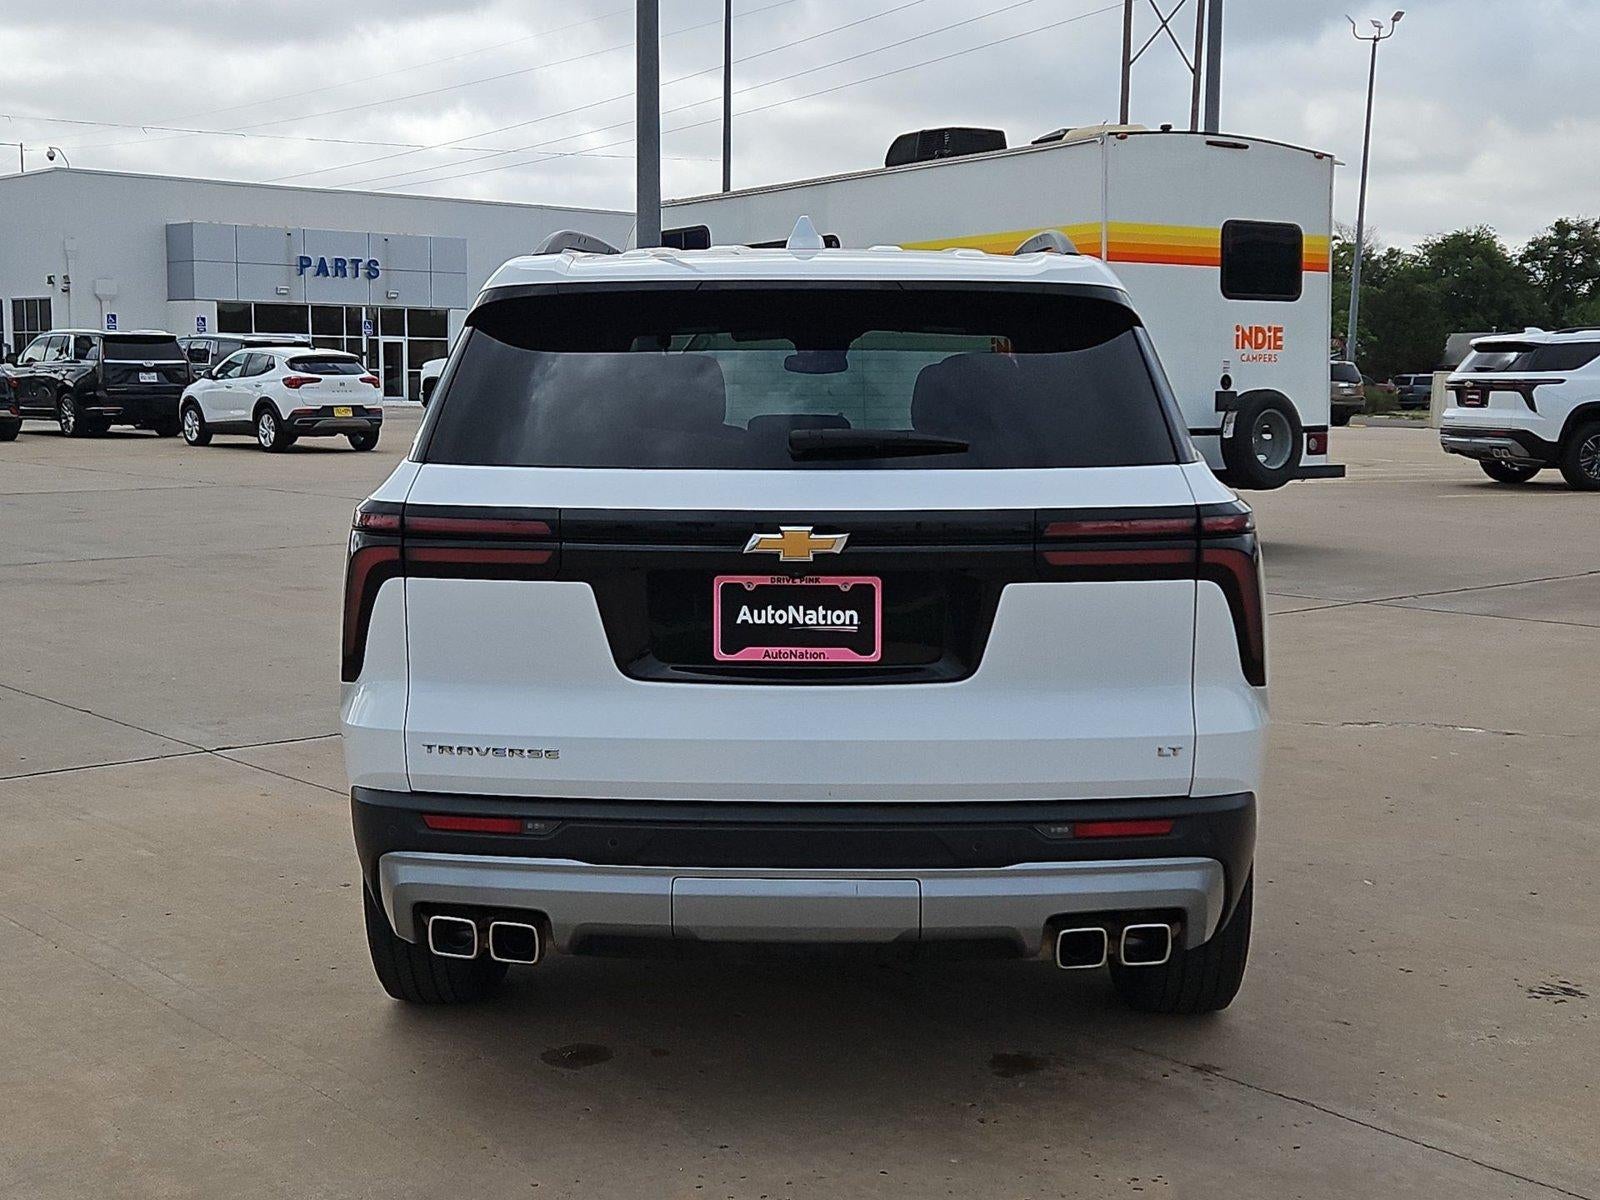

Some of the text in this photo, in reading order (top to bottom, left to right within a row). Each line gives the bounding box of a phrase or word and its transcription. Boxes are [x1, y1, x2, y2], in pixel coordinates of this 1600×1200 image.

[296, 255, 380, 280] PARTS
[1240, 353, 1278, 363] CAMPERS
[770, 576, 821, 584] DRIVE PINK
[736, 605, 859, 625] AutoNation
[422, 743, 560, 760] TRAVERSE
[1157, 746, 1183, 757] LT
